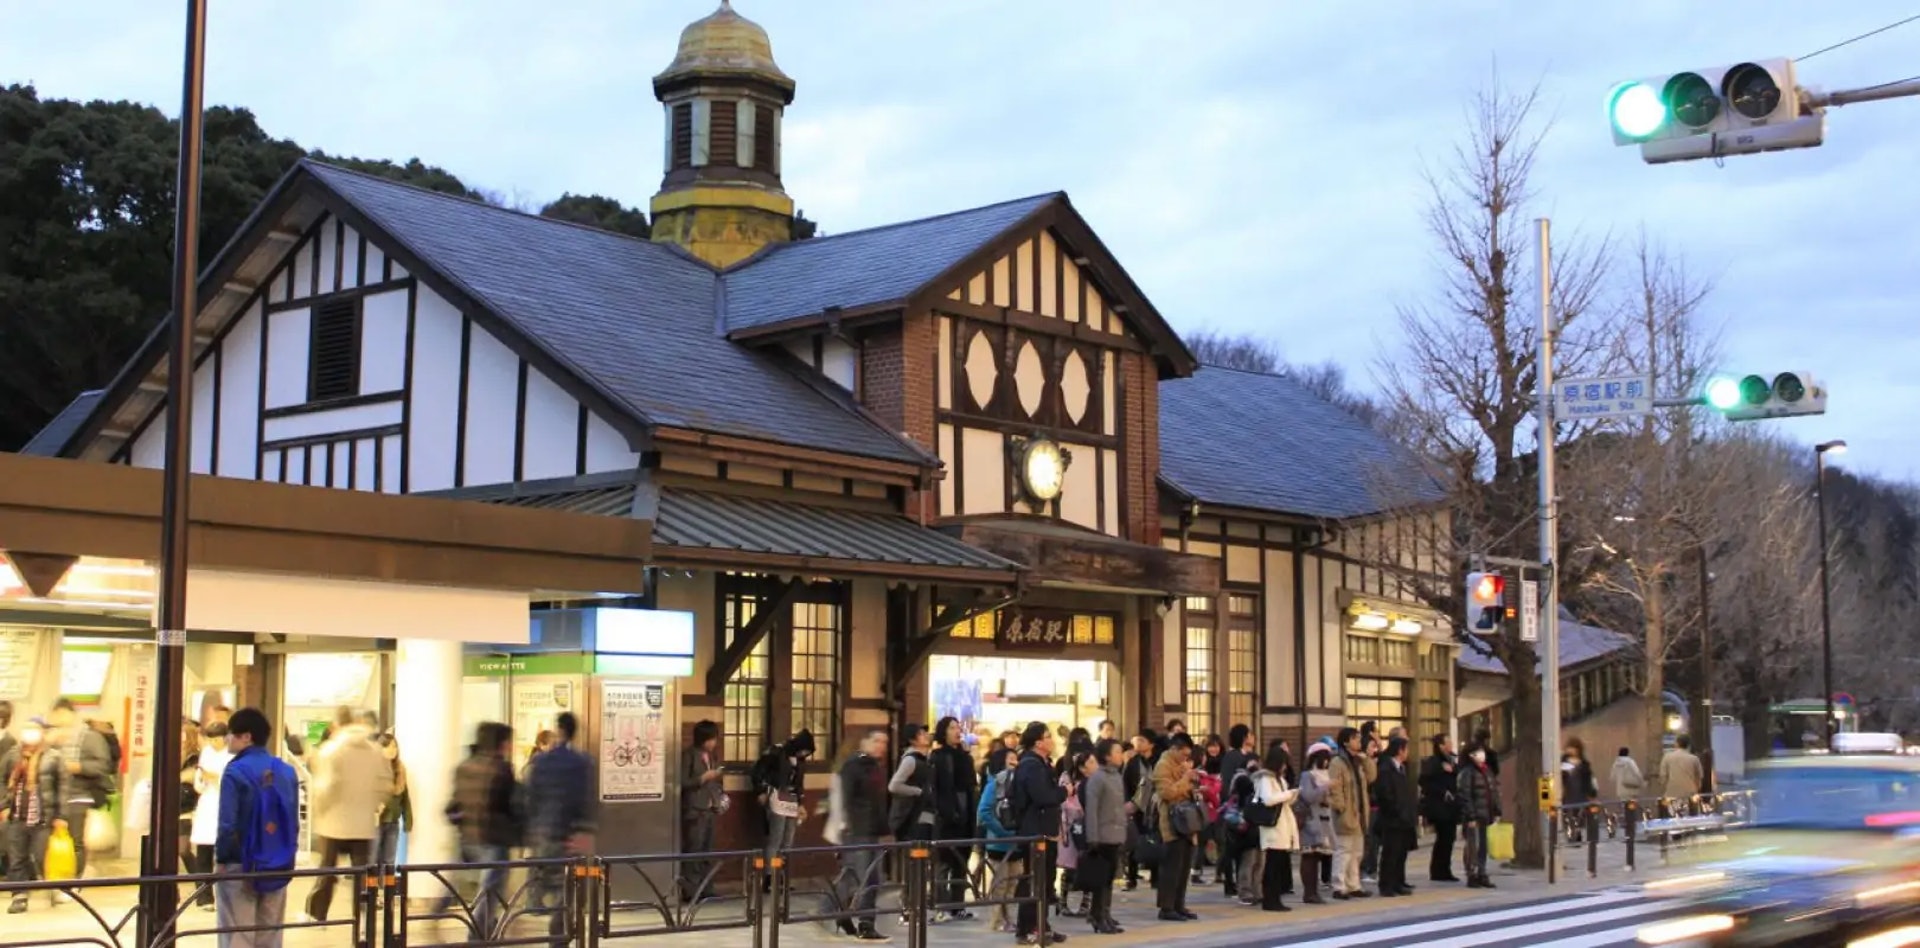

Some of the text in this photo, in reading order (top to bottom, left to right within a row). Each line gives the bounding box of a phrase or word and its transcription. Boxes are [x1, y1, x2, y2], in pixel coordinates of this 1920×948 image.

[1564, 380, 1643, 403] 原宿駅前
[1005, 614, 1065, 643] 原宿駅
[479, 662, 499, 670] VIEW
